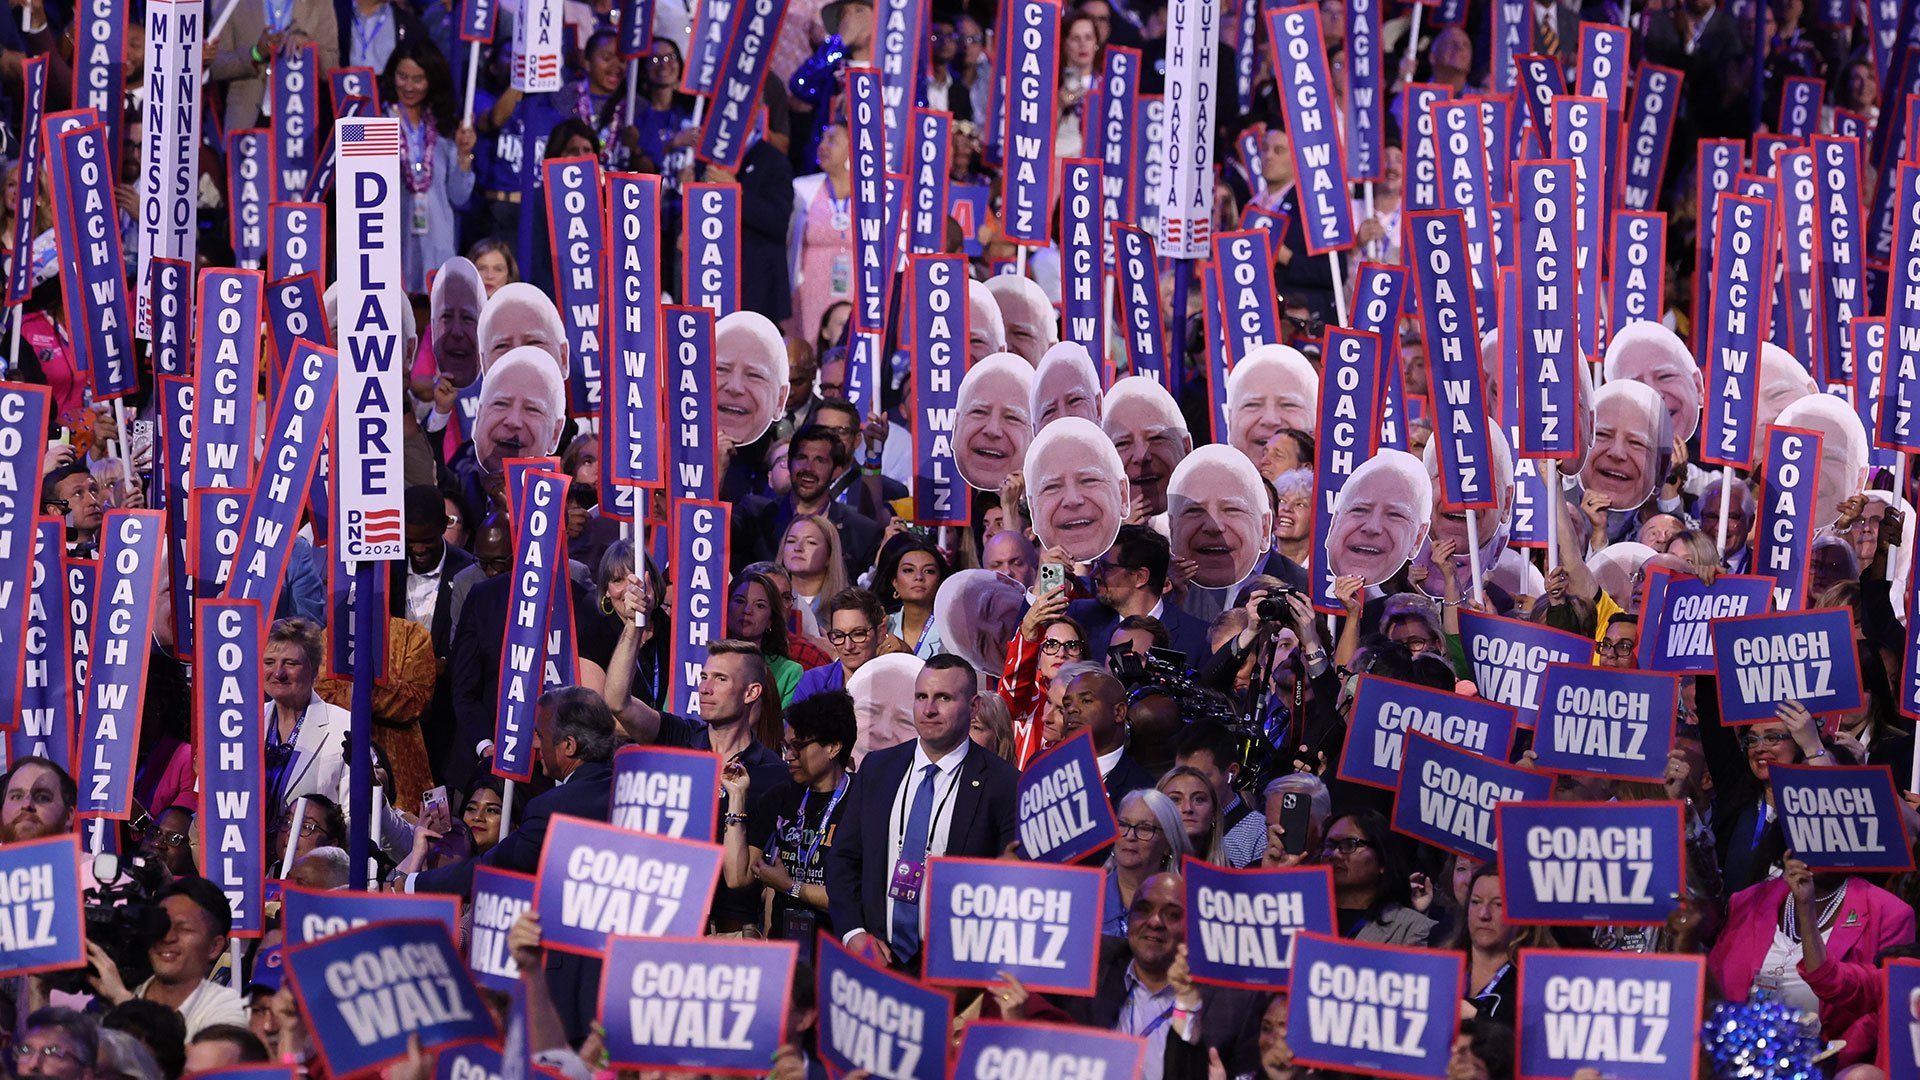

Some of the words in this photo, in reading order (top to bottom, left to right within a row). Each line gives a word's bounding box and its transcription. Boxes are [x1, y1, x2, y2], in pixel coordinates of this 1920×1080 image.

[88, 0, 112, 111] COACH
[528, 54, 537, 88] DNC
[699, 0, 731, 85] WALZ
[737, 0, 773, 75] OACH
[1020, 3, 1042, 124] COACH
[1284, 13, 1323, 134] COACH
[1503, 4, 1524, 88] WALZ
[1591, 32, 1613, 98] COA
[174, 13, 197, 258] MINNESOT
[712, 77, 750, 158] WALZ
[856, 76, 876, 203] COACH
[1106, 54, 1128, 165] COACH
[1144, 101, 1164, 206] COACH
[1167, 80, 1182, 207] DAKOTA
[1194, 82, 1209, 208] DAKOTA
[1353, 88, 1374, 171] WALZ
[1416, 90, 1436, 206] COACH
[1632, 72, 1668, 178] COACH
[78, 134, 108, 266] COACH
[240, 135, 260, 248] COACH
[918, 116, 938, 234] COACH
[1016, 134, 1041, 232] WALZ
[1104, 176, 1124, 265] WALZ
[1302, 143, 1340, 240] WALZ
[1826, 144, 1852, 264] COACH
[562, 166, 593, 289] COACH
[622, 183, 642, 333] COACH
[860, 218, 881, 320] WALZ
[1072, 166, 1093, 300] COACH
[1186, 218, 1194, 253] DNC
[1533, 168, 1557, 310] COACH
[1726, 204, 1752, 334] COACH
[92, 279, 122, 385] WALZ
[160, 266, 178, 372] COAC
[348, 171, 397, 496] DELAWARE
[928, 262, 951, 393] COACH
[1126, 234, 1154, 355] COACH
[1426, 219, 1463, 362] COACH
[1832, 276, 1856, 373] WALZ
[212, 278, 242, 425] COACH
[572, 304, 602, 403] WALZ
[678, 314, 700, 448] COACH
[1533, 328, 1563, 442] WALZ
[1720, 348, 1748, 452] WALZ
[268, 354, 324, 504] COACH
[623, 350, 646, 469] WALZ
[1331, 338, 1361, 476] COACH
[1443, 380, 1478, 494] WALZ
[926, 408, 953, 511] WALZ
[1514, 457, 1538, 532] ALZ
[1772, 436, 1802, 571] COACH
[348, 510, 362, 555] DNC
[364, 544, 400, 555] 2024
[518, 480, 552, 628] COACH
[689, 509, 713, 647] COACH
[104, 518, 144, 666] COACH
[1672, 594, 1749, 622] COACH
[217, 609, 244, 771] COACH
[1294, 680, 1302, 706] Canon
[1473, 662, 1540, 710] WAL
[1732, 630, 1829, 666] COACH
[1735, 660, 1836, 704] WALZ
[90, 684, 128, 800] WALZ
[502, 644, 536, 763] WALZ
[1378, 700, 1490, 751] COACH
[1553, 714, 1649, 762] WALZ
[1556, 684, 1650, 722] COACH
[1019, 758, 1085, 821] COACH
[1020, 790, 1097, 861] WALZ
[1420, 786, 1498, 851] WAL
[1782, 786, 1877, 815] COACH
[1786, 816, 1886, 852] WALZ
[216, 791, 250, 919] WALZ
[566, 845, 691, 900] COACH
[1526, 826, 1654, 861] COACH
[1528, 861, 1655, 905] WALZ
[560, 880, 682, 938] WALZ
[950, 882, 1072, 924] COACH
[950, 918, 1070, 970] WALZ
[1198, 886, 1305, 926] COACH
[325, 942, 450, 1000] COACH
[336, 978, 474, 1046] WALZ
[630, 961, 762, 1002] COACH
[830, 968, 924, 1043] COACH
[1308, 960, 1431, 1012] COACH
[1544, 976, 1672, 1016] COACH
[628, 998, 758, 1051] WALZ
[830, 1003, 922, 1080] WALZ
[1307, 996, 1428, 1059] WALZ
[1544, 1014, 1671, 1064] WALZ
